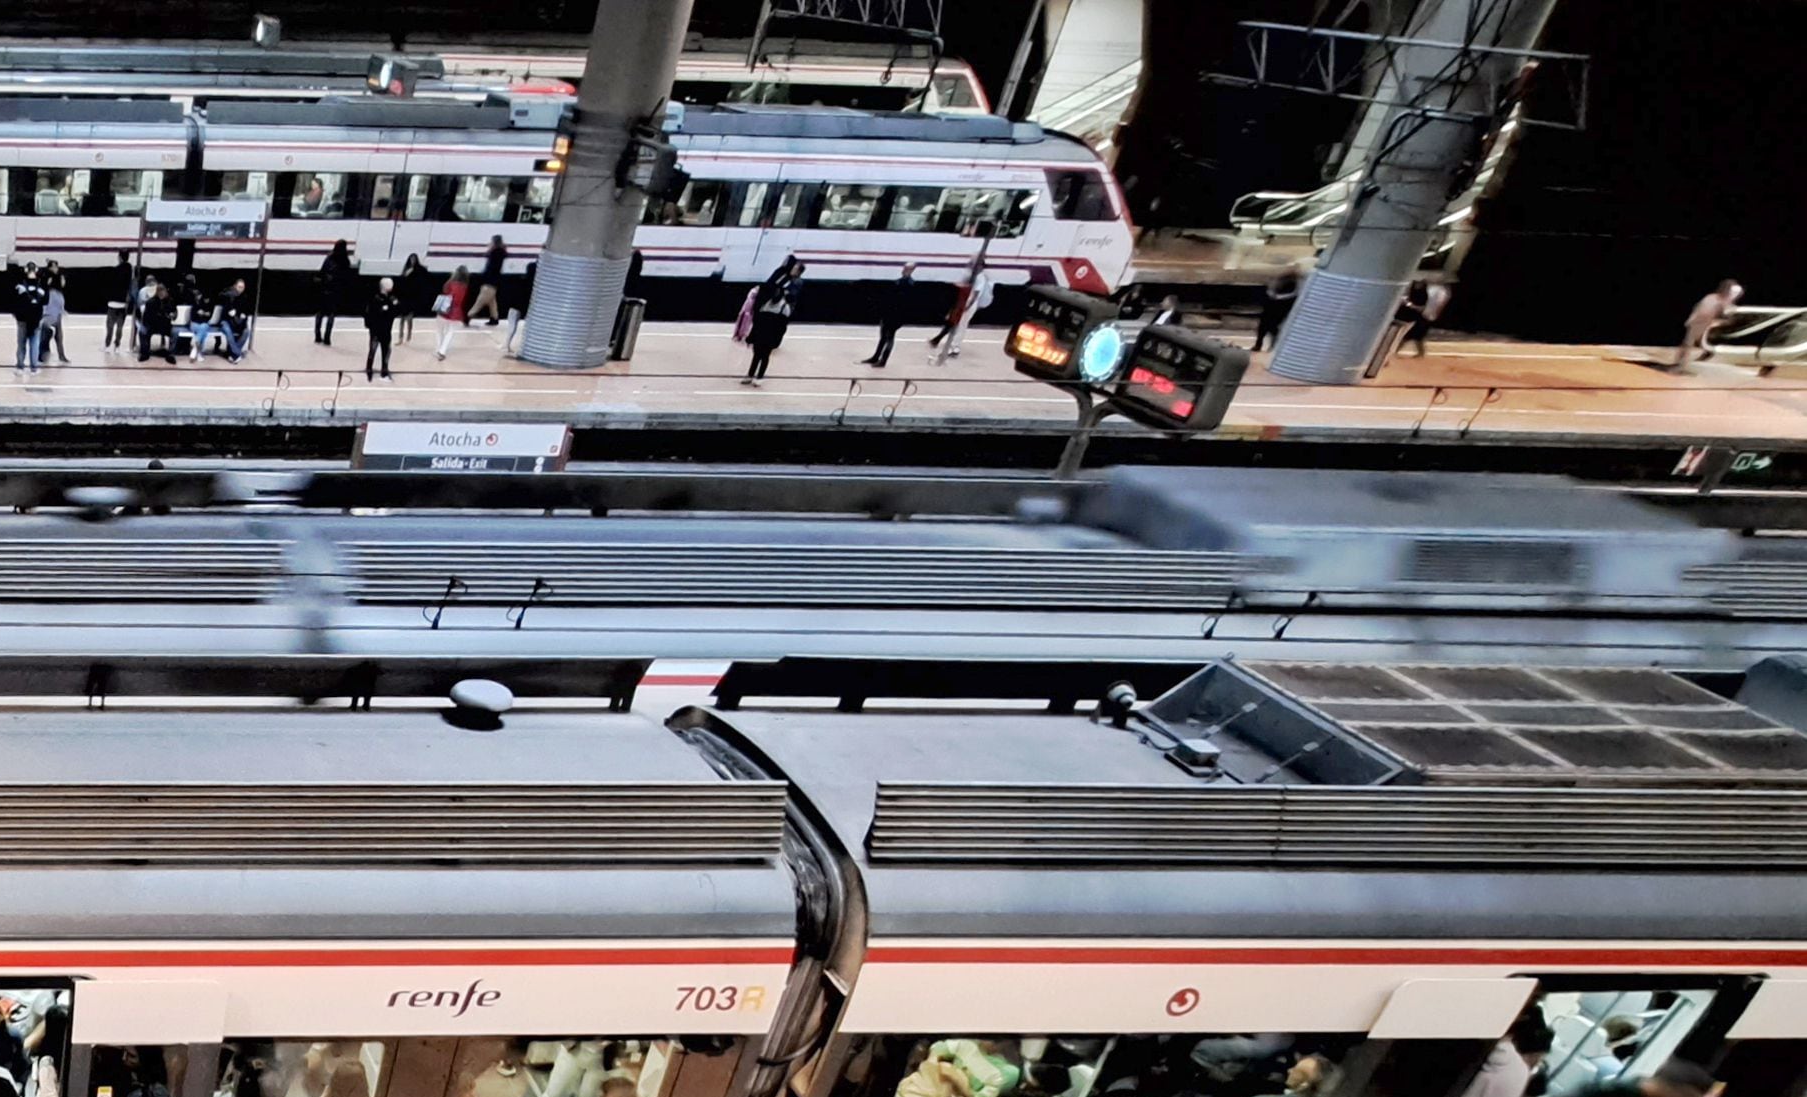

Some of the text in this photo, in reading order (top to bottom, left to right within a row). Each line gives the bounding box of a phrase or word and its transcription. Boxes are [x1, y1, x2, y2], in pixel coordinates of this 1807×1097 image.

[184, 205, 217, 216] Atocha
[428, 431, 482, 447] Atocha
[387, 978, 502, 1018] renfe
